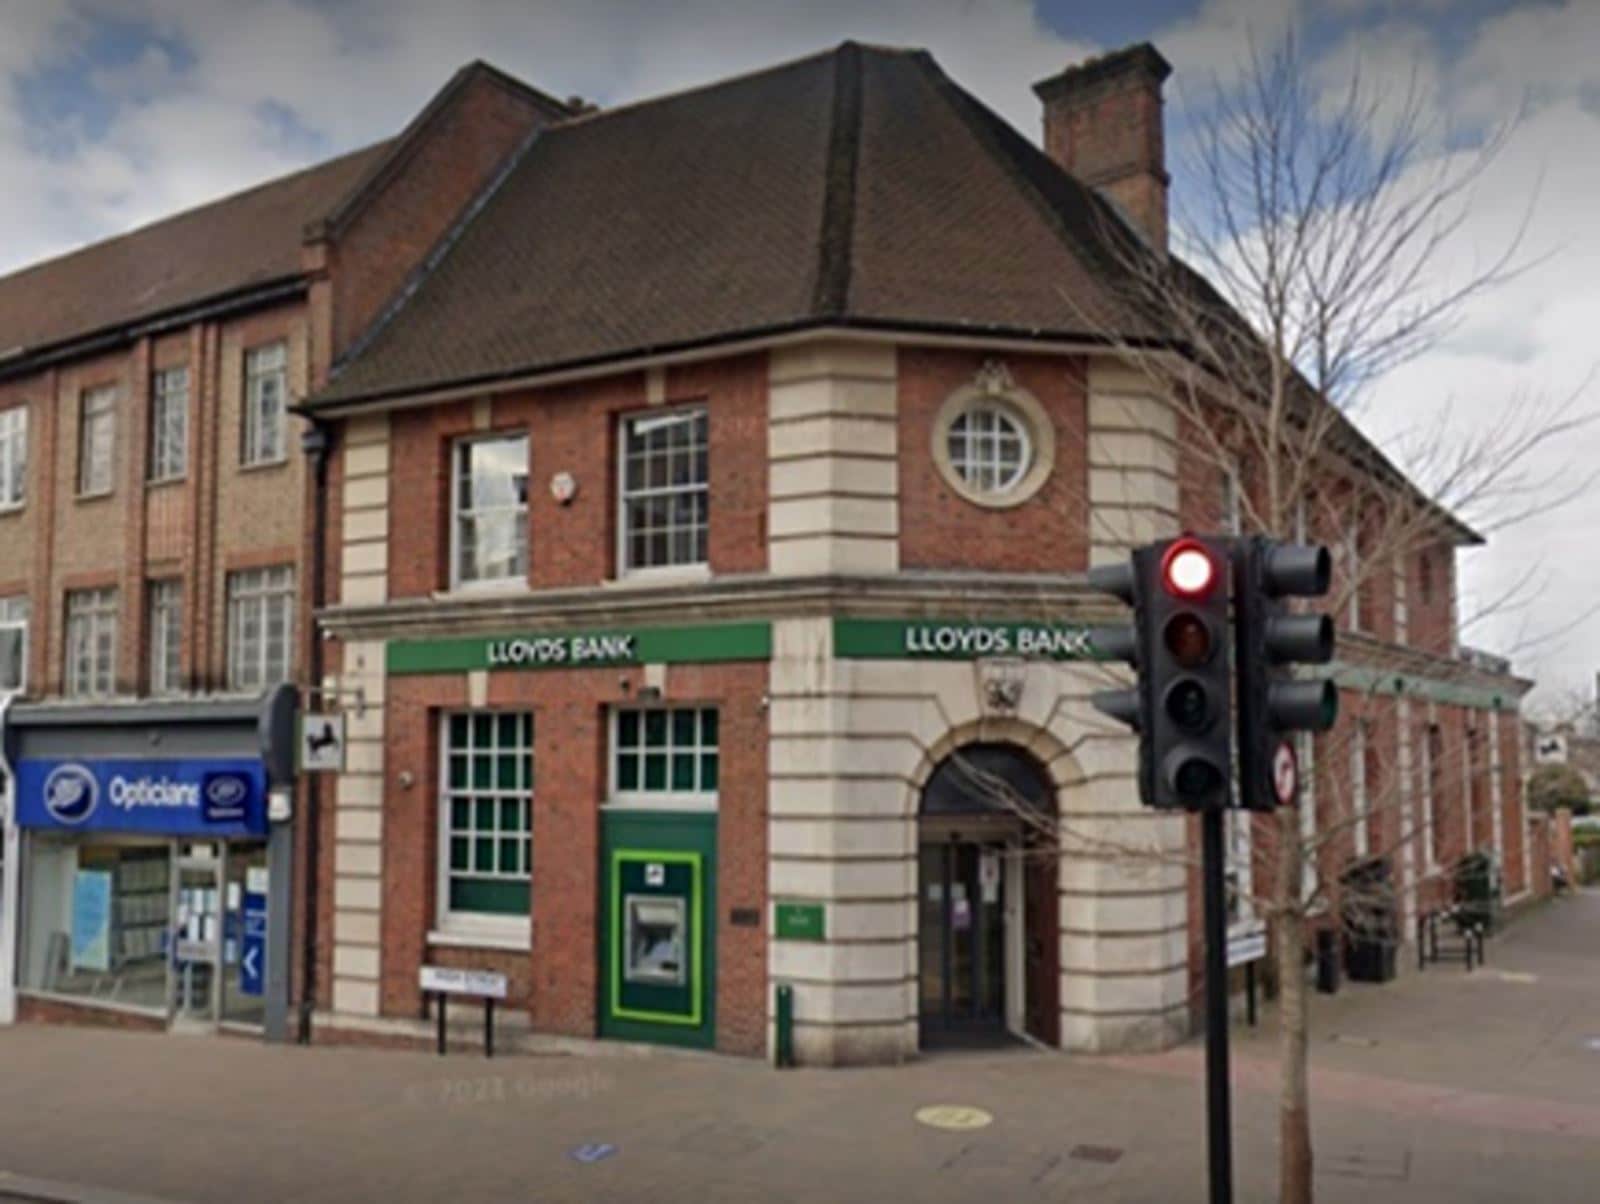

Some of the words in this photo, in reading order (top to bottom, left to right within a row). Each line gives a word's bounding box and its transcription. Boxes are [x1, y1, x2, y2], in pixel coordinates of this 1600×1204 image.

[486, 637, 566, 664] LLOYDS
[570, 634, 633, 662] BANK
[906, 626, 1009, 652] LLOYDS
[1016, 628, 1092, 654] BANK
